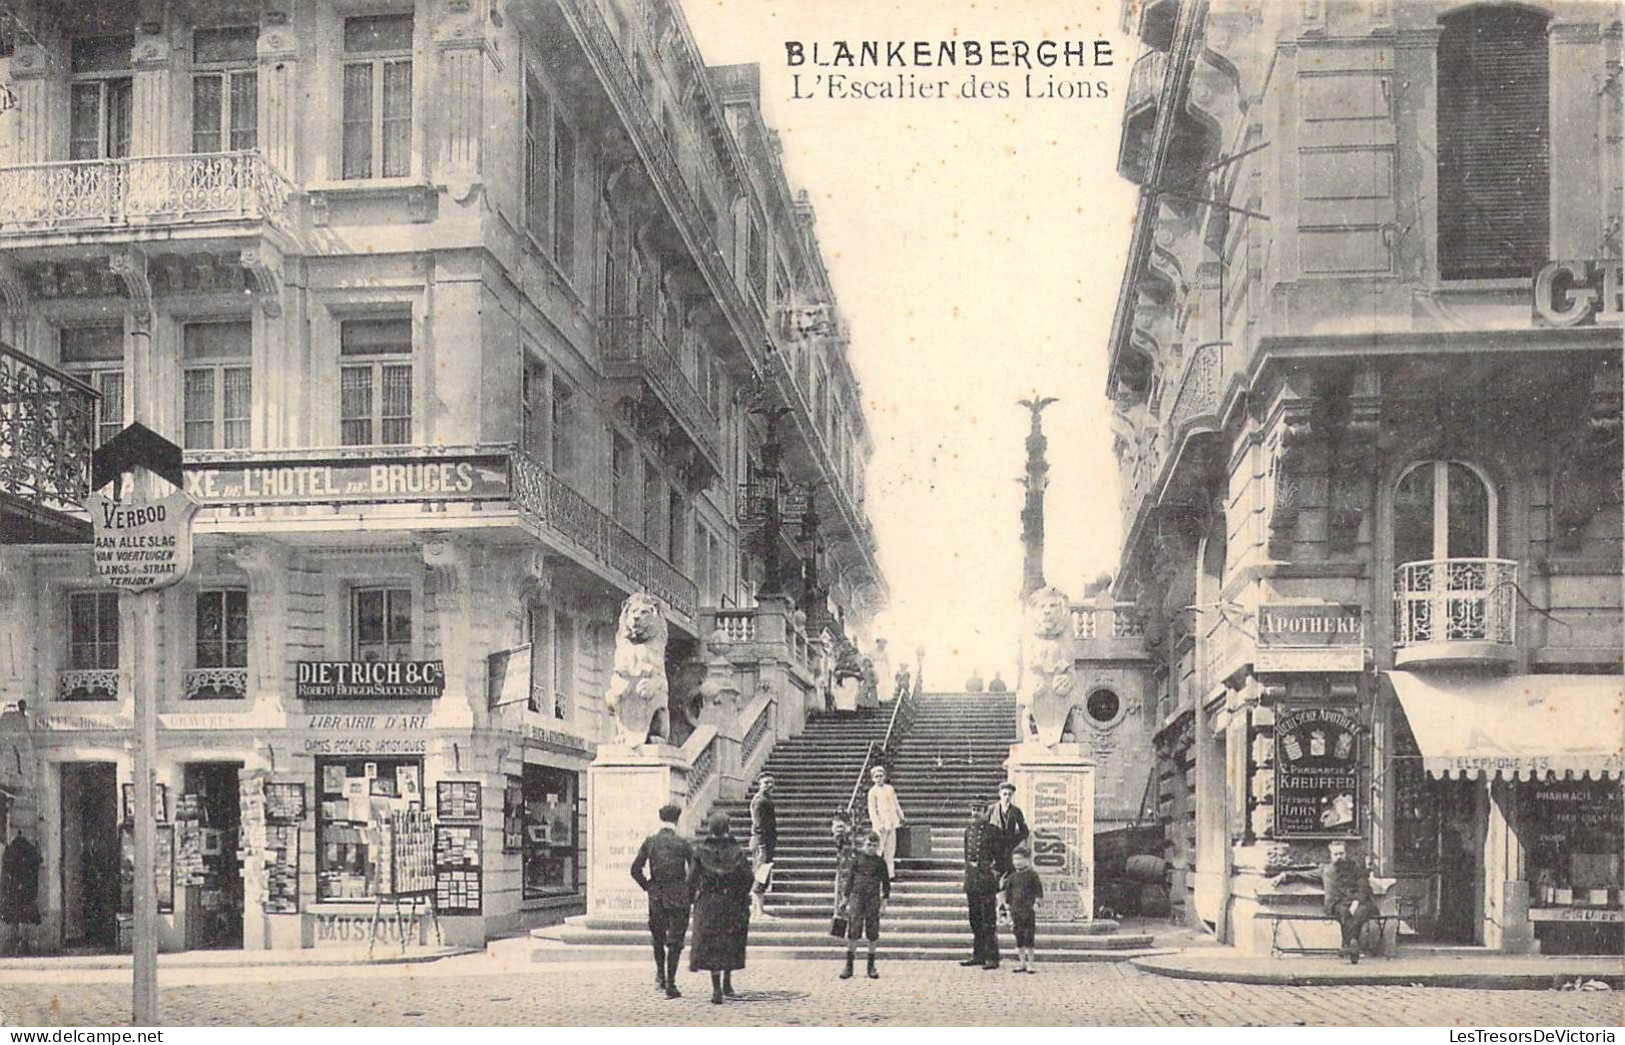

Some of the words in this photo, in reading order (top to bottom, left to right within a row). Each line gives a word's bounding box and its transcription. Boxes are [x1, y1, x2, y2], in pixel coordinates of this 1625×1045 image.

[244, 466, 341, 497] L'HOTEL
[370, 462, 473, 494] BRUGES
[101, 502, 167, 530] VERBOD
[95, 537, 116, 549] AAN
[119, 536, 145, 548] ALLE
[147, 536, 176, 548] SLAG
[95, 552, 113, 563] VAN
[116, 550, 175, 562] VOERTUIGEN
[100, 565, 130, 576] LANGS
[143, 563, 177, 575] STRAAT
[1260, 612, 1360, 633] APOTHEKE
[299, 661, 400, 685] DIETRICH
[300, 684, 335, 696] ROBERT
[1280, 774, 1356, 789] KAEUFFER
[1033, 781, 1067, 868] CARUSO
